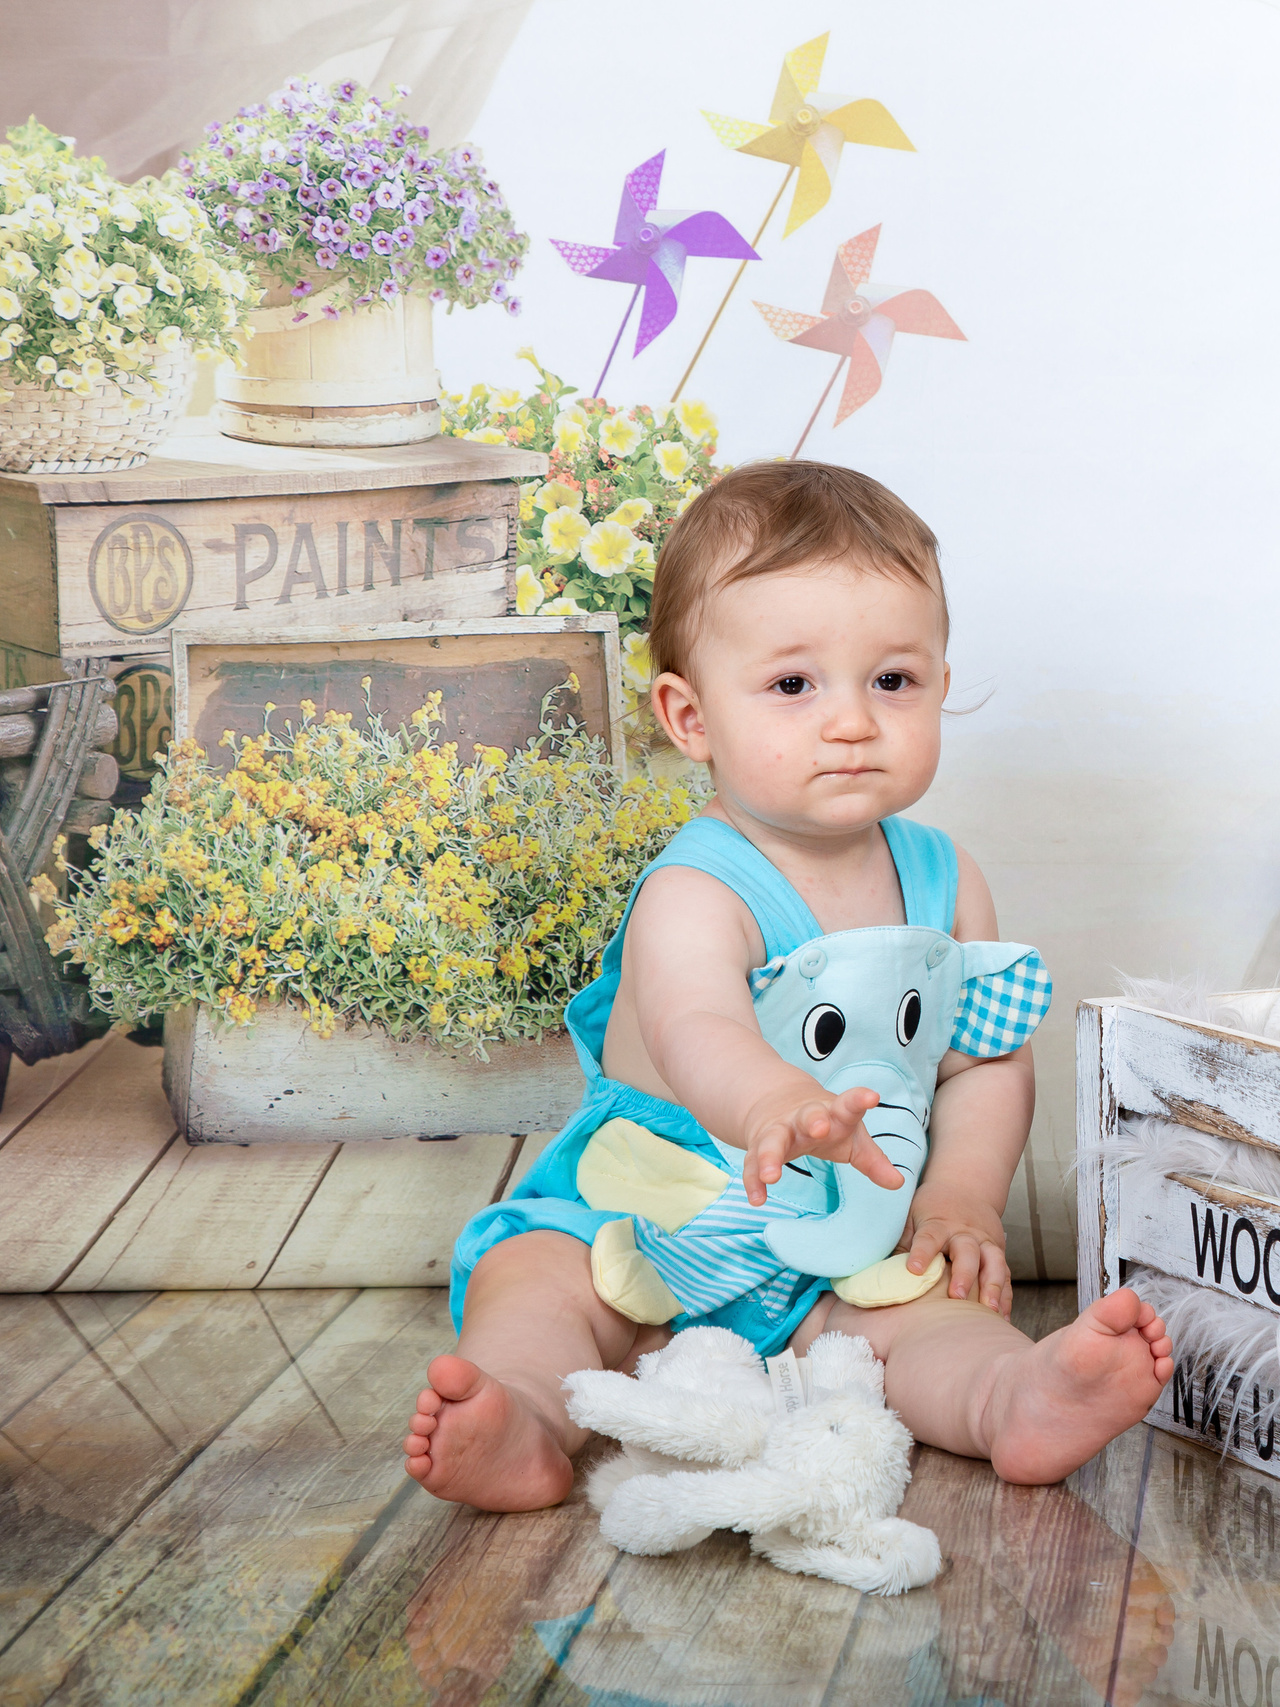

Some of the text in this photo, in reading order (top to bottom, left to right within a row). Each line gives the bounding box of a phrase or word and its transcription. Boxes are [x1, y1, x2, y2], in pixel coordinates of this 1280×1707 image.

[106, 514, 496, 624] BPS PAINTS
[778, 1361, 794, 1393] Horse
